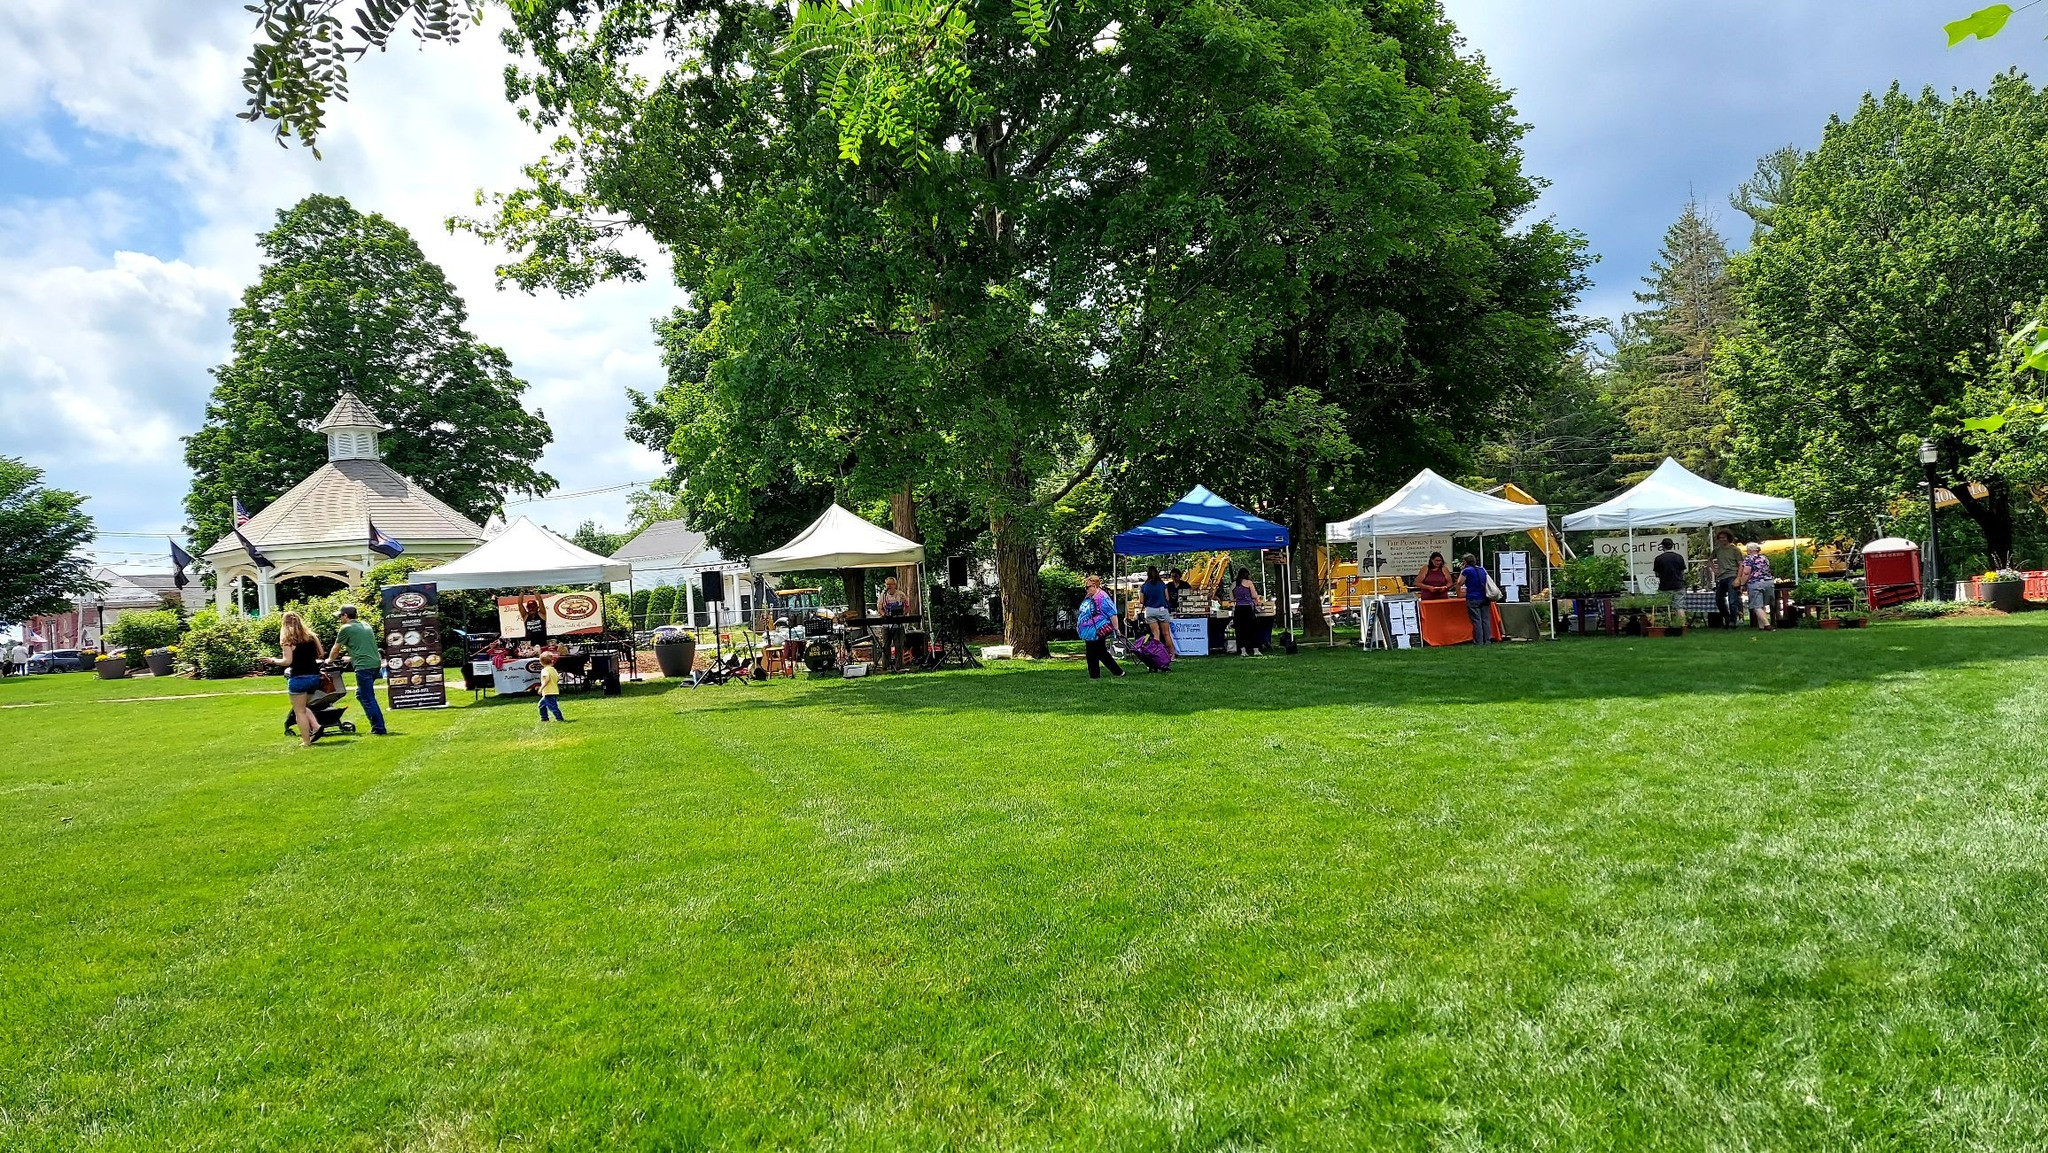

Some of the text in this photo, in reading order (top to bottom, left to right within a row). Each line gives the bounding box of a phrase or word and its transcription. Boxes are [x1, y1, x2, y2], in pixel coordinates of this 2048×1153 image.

[1601, 541, 1680, 554] Ox Cart Fam
